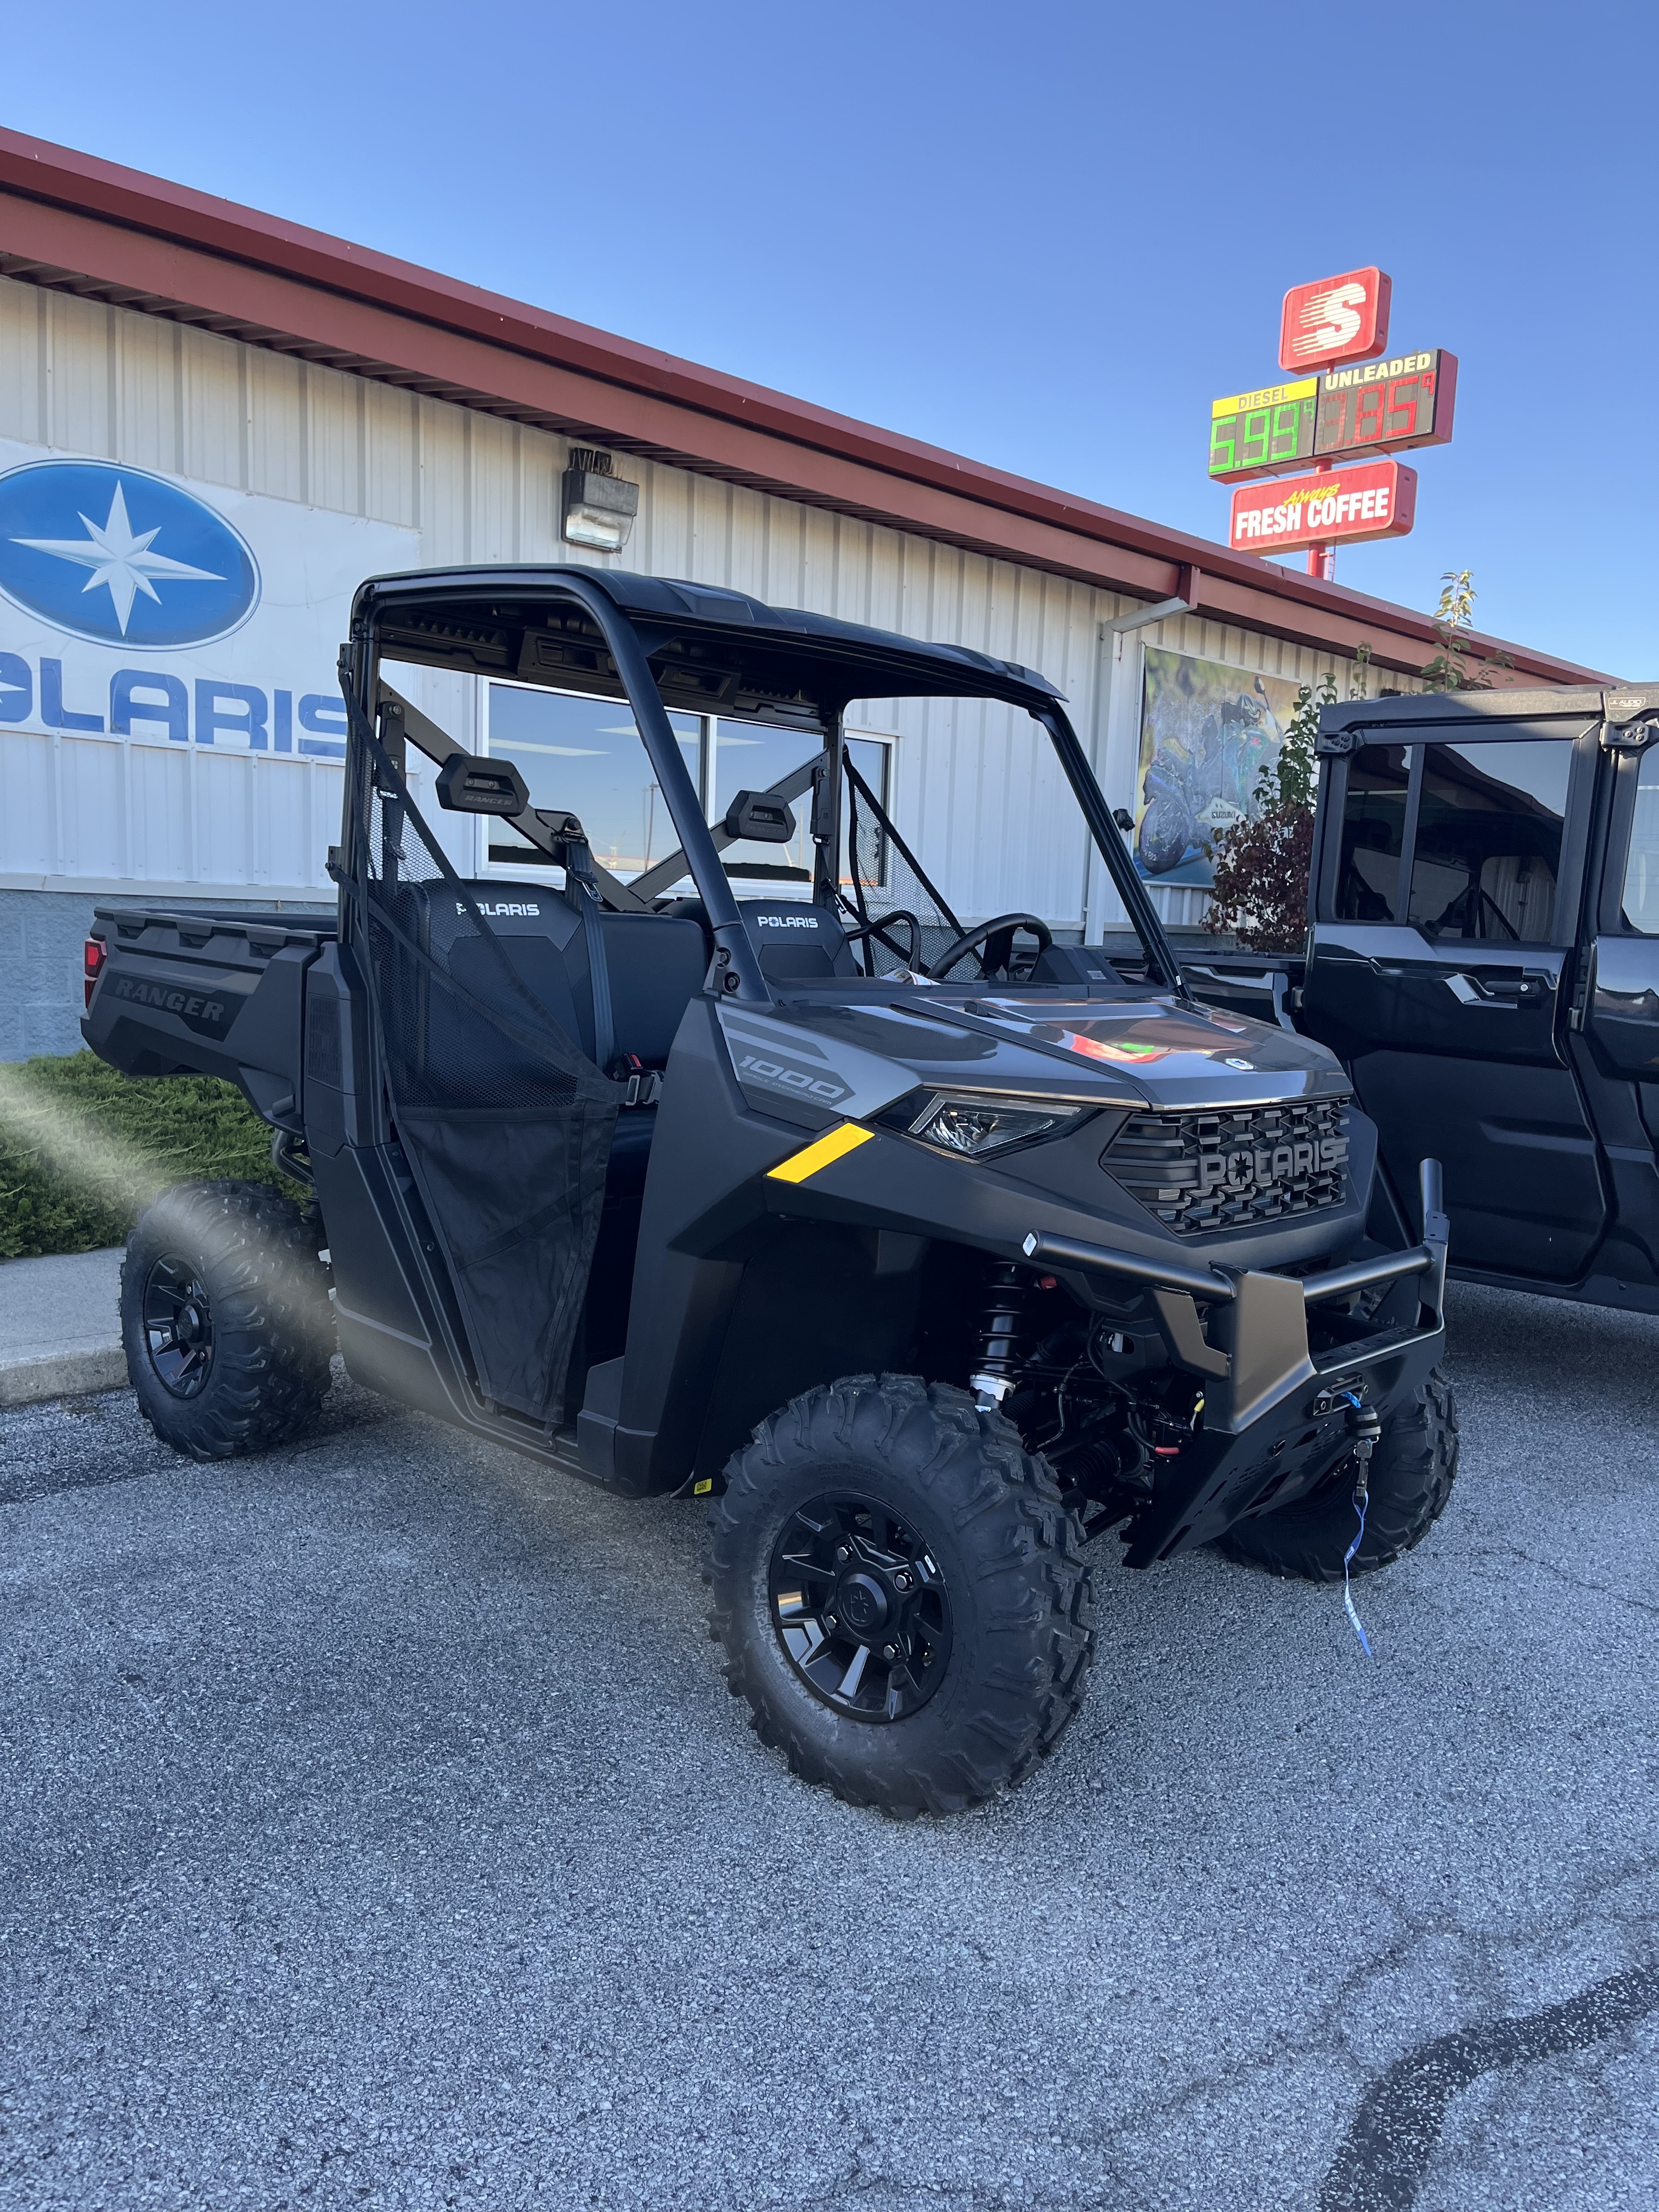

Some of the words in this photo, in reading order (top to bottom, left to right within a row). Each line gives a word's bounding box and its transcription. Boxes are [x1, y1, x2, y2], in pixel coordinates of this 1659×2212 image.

[1292, 283, 1366, 356] S
[1325, 353, 1431, 390] UNLEADED
[1238, 387, 1288, 410] DIESEL
[1235, 503, 1302, 539] FRESH
[1307, 487, 1389, 528] COFFEE
[1283, 483, 1340, 508] Always
[465, 795, 512, 805] RANGER
[757, 916, 819, 928] POLARIS
[115, 979, 225, 1022] RANGER
[738, 1055, 845, 1099] 1000
[771, 1081, 814, 1098] OVERHEAD
[814, 1097, 832, 1105] CAM
[1198, 1136, 1350, 1190] POLARIS
